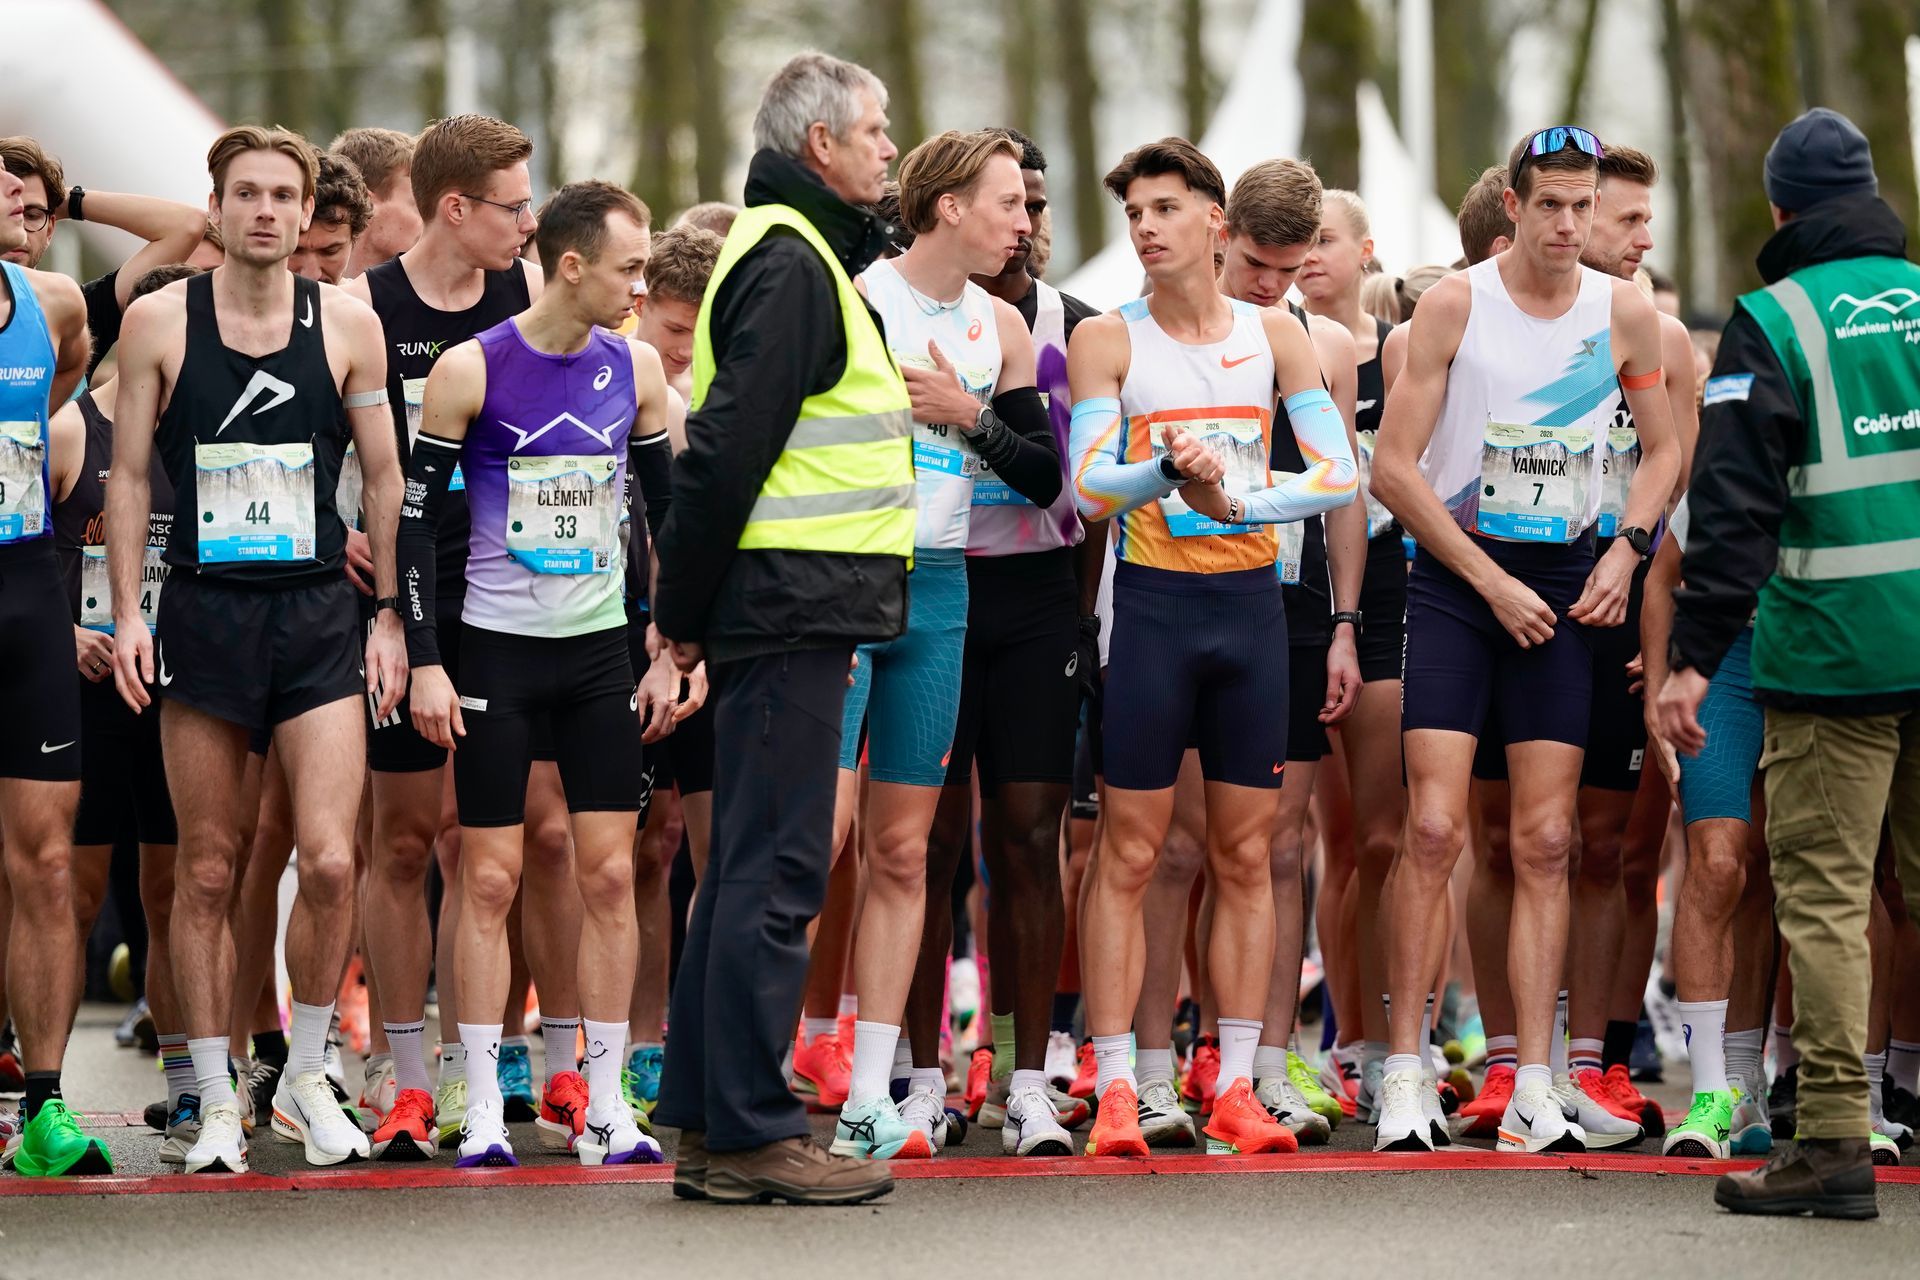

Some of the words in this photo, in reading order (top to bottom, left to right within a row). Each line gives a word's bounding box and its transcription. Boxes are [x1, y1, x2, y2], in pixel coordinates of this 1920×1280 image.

[1834, 321, 1891, 340] Midwinter
[396, 340, 448, 358] RUNX
[1205, 422, 1220, 431] 2026
[914, 453, 942, 466] STARTVAK
[942, 458, 950, 469] W
[1512, 456, 1567, 477] YANNICK
[537, 489, 594, 507] CLEMENT
[1002, 490, 1010, 500] W
[1532, 482, 1544, 506] 7
[245, 501, 271, 525] 44
[554, 514, 577, 539] 33
[1195, 522, 1224, 530] STARTVAK
[1513, 525, 1543, 535] STARTVAK
[1544, 526, 1553, 537] W
[145, 536, 168, 547] AR
[238, 546, 269, 556] STARTVAK
[269, 545, 278, 556] W
[543, 560, 573, 569] STARTVAK
[573, 559, 581, 569] W
[141, 566, 168, 583] IAM
[408, 578, 424, 621] CRAFT
